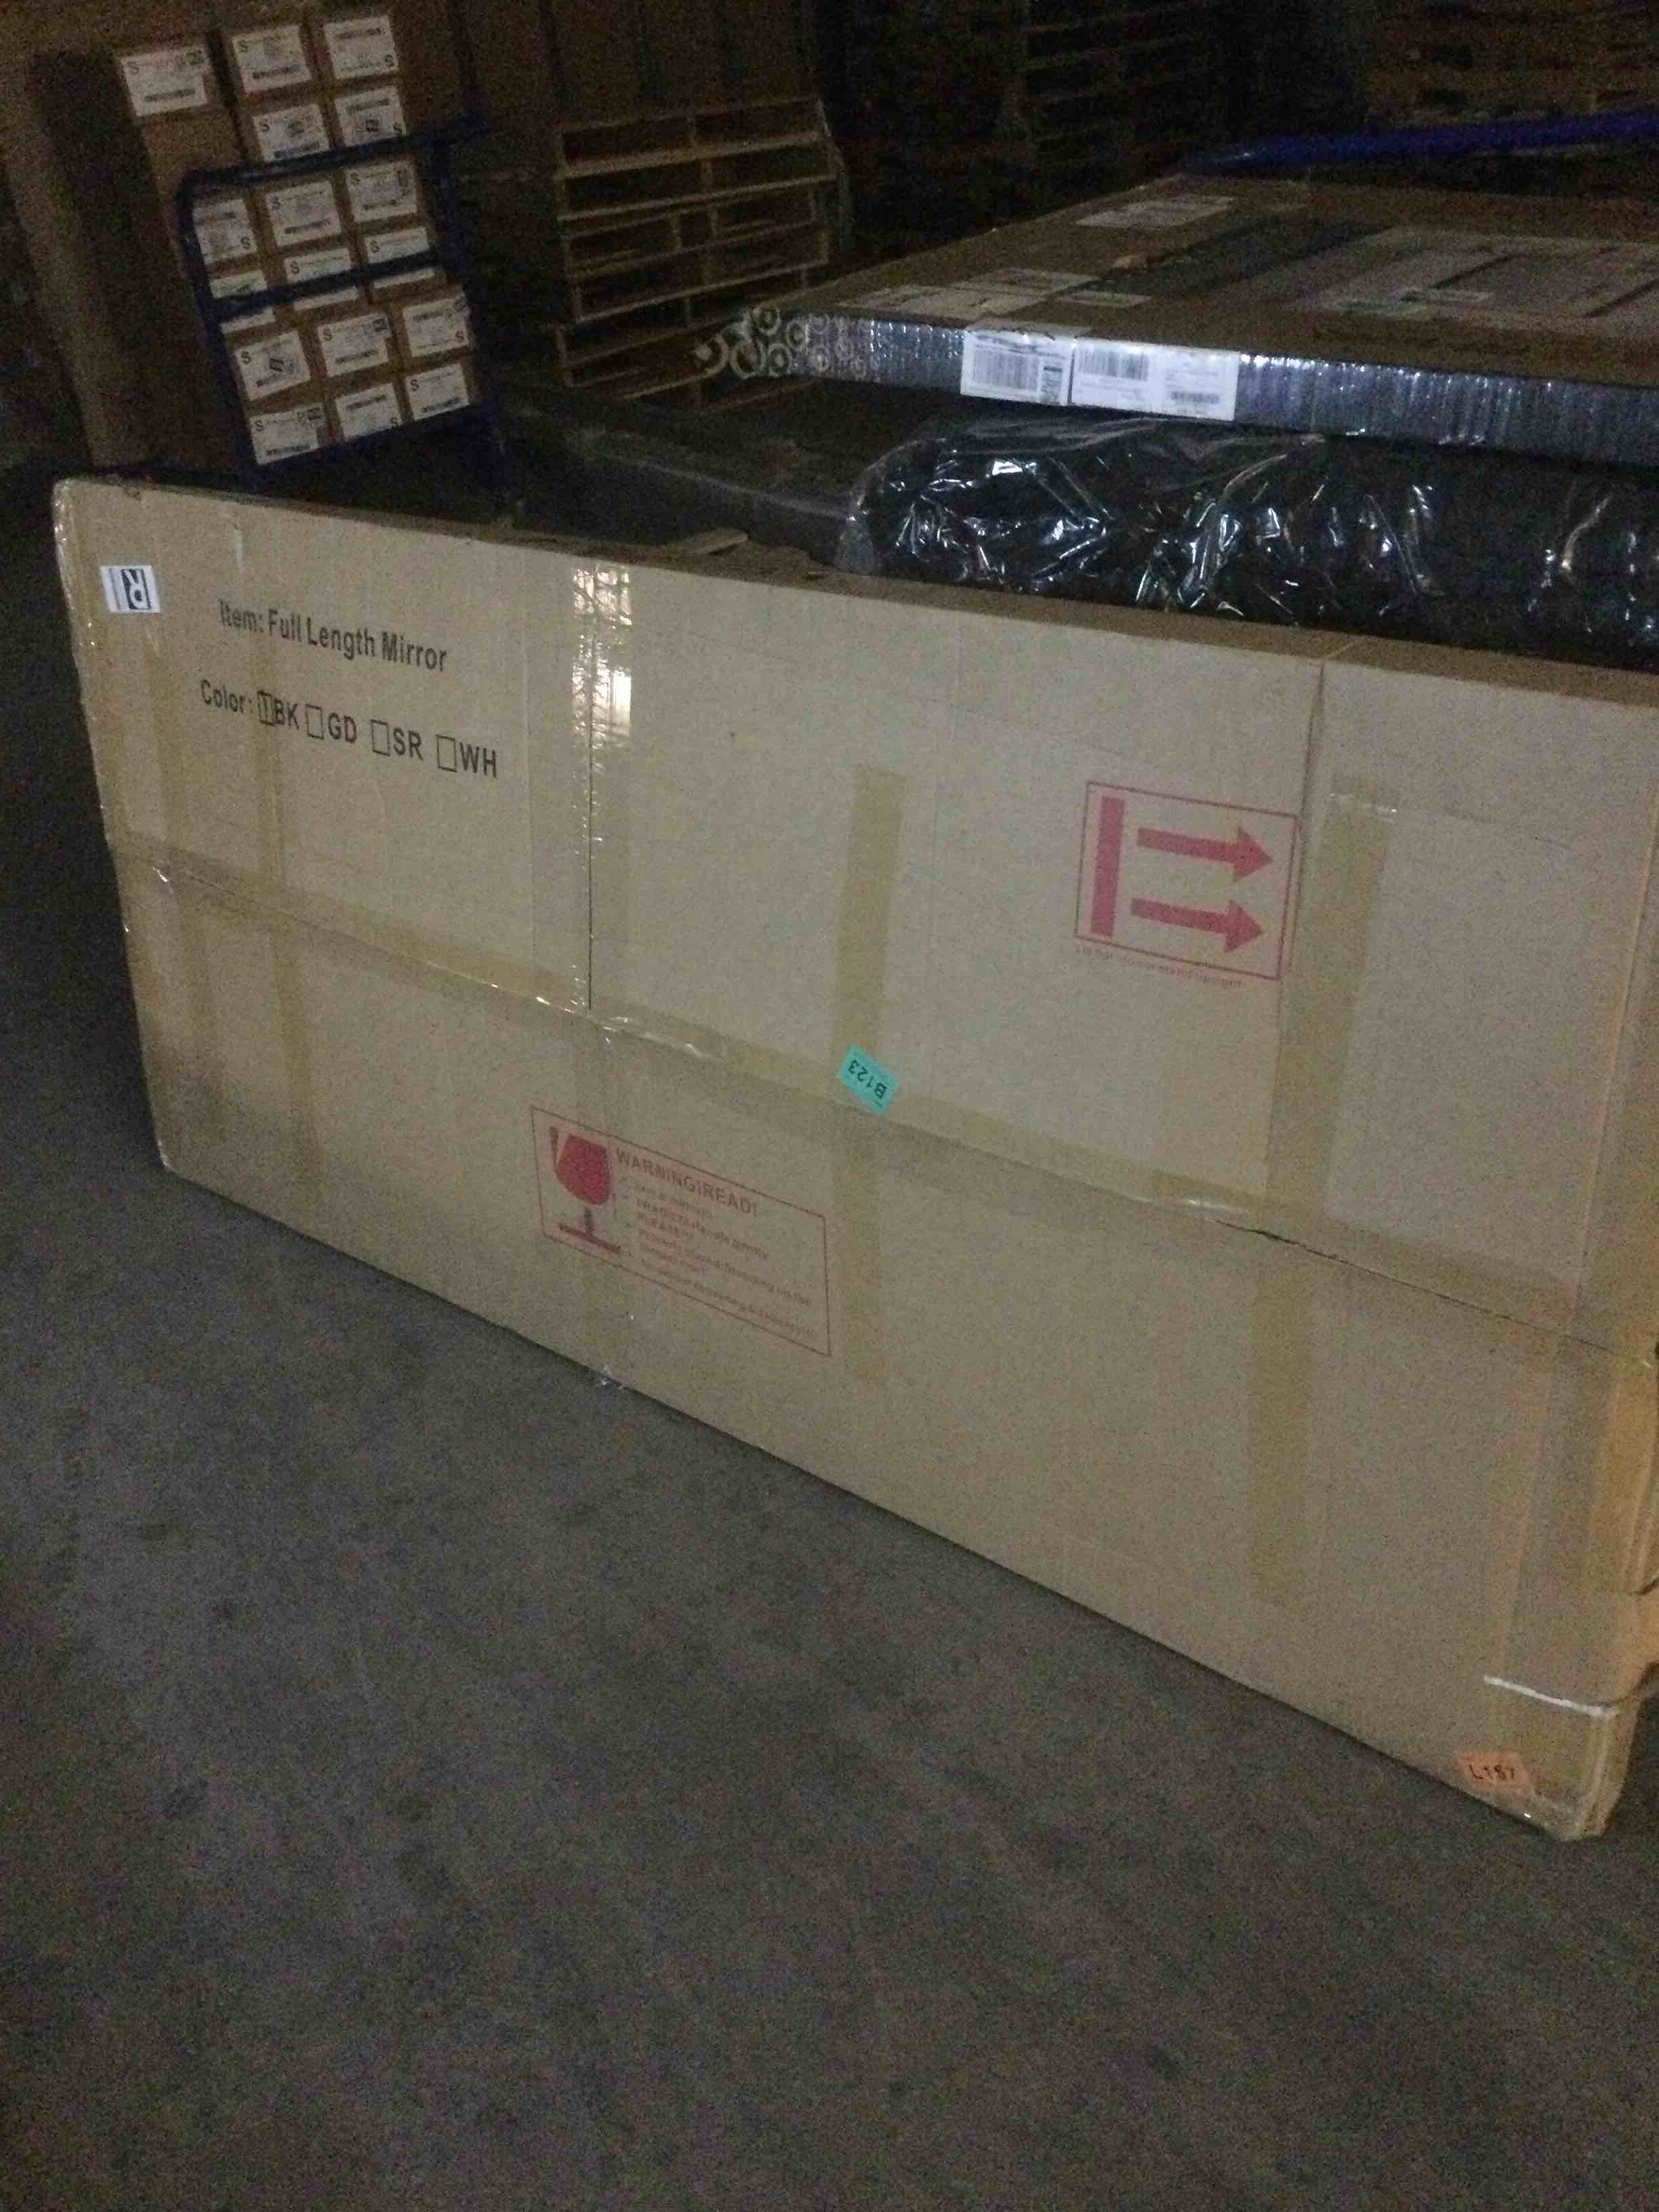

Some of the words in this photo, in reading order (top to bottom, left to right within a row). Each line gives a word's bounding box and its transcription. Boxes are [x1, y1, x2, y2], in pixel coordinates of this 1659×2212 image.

[220, 599, 264, 632] Item:
[268, 609, 302, 641] Full
[306, 617, 375, 660] Length
[382, 631, 447, 672] Mirror
[200, 678, 253, 714] Color:
[273, 697, 300, 730] BK
[327, 712, 358, 743] GD
[392, 727, 424, 760] SR
[459, 741, 498, 779] WH
